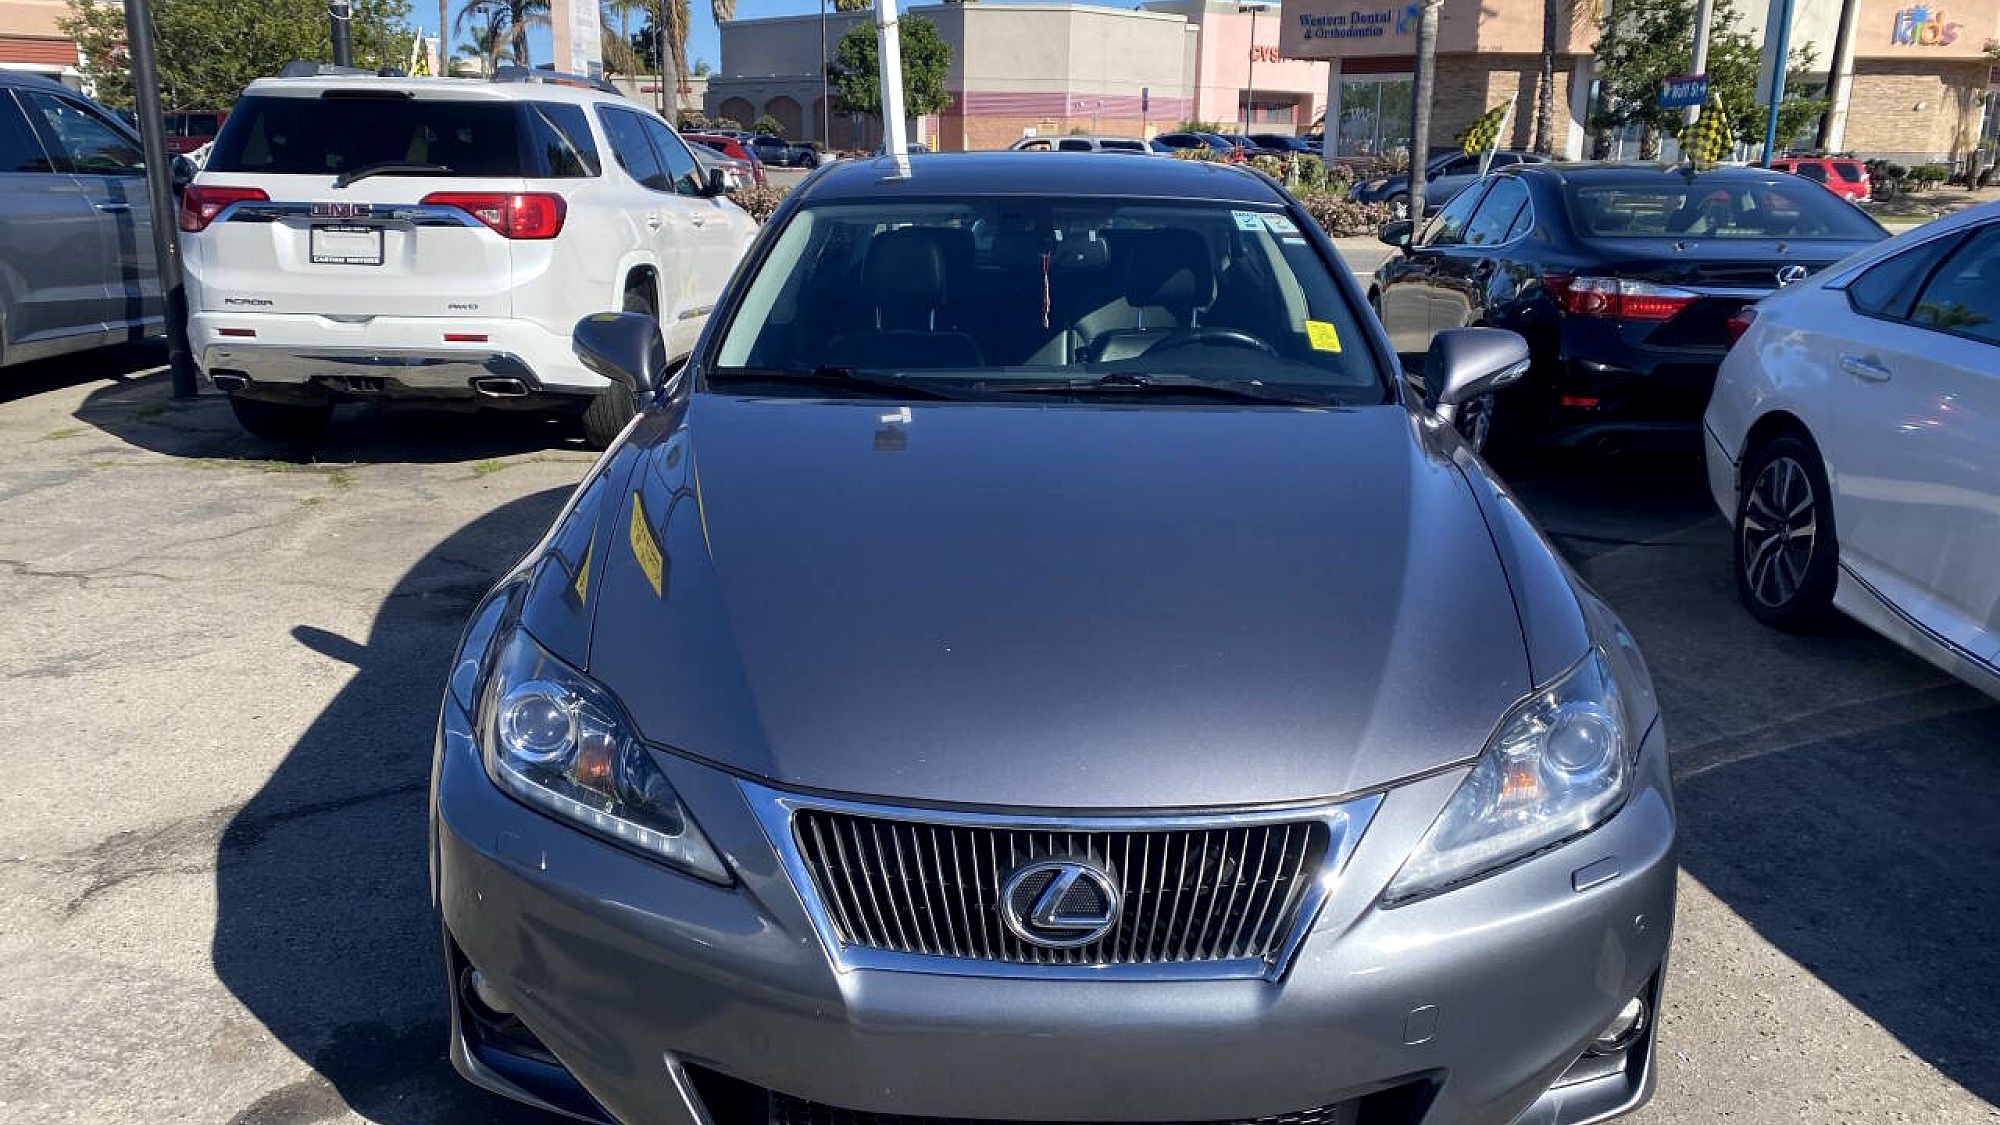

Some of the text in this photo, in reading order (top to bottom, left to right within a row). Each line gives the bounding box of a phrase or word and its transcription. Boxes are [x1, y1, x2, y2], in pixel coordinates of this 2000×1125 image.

[1299, 12, 1346, 26] Western
[1351, 8, 1391, 24] Dental
[1304, 25, 1384, 38] & Orthodontics
[311, 202, 372, 218] GMC
[224, 298, 274, 306] ACADIA
